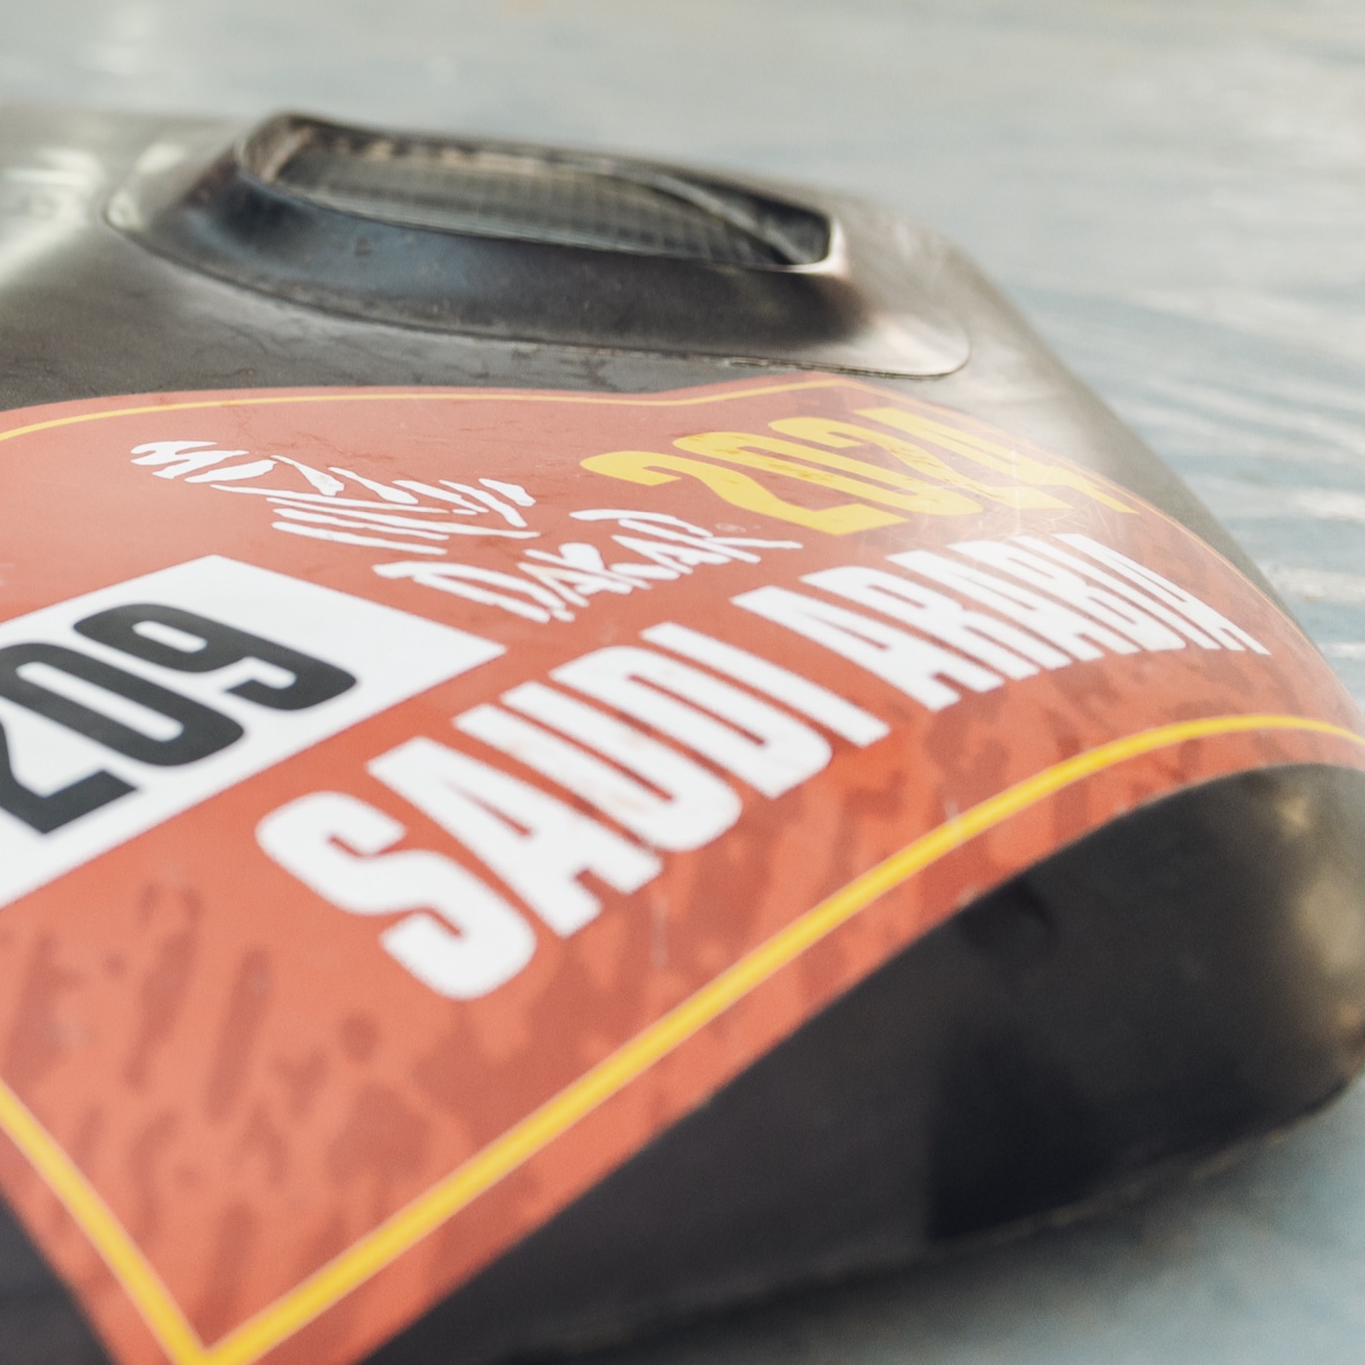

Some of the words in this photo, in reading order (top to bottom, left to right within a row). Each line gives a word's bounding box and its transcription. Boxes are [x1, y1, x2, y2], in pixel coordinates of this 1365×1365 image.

[579, 406, 1139, 535] 2024
[372, 507, 804, 623] DAKAR
[254, 621, 891, 1001] SAUDI
[730, 531, 1273, 712] ARABIA
